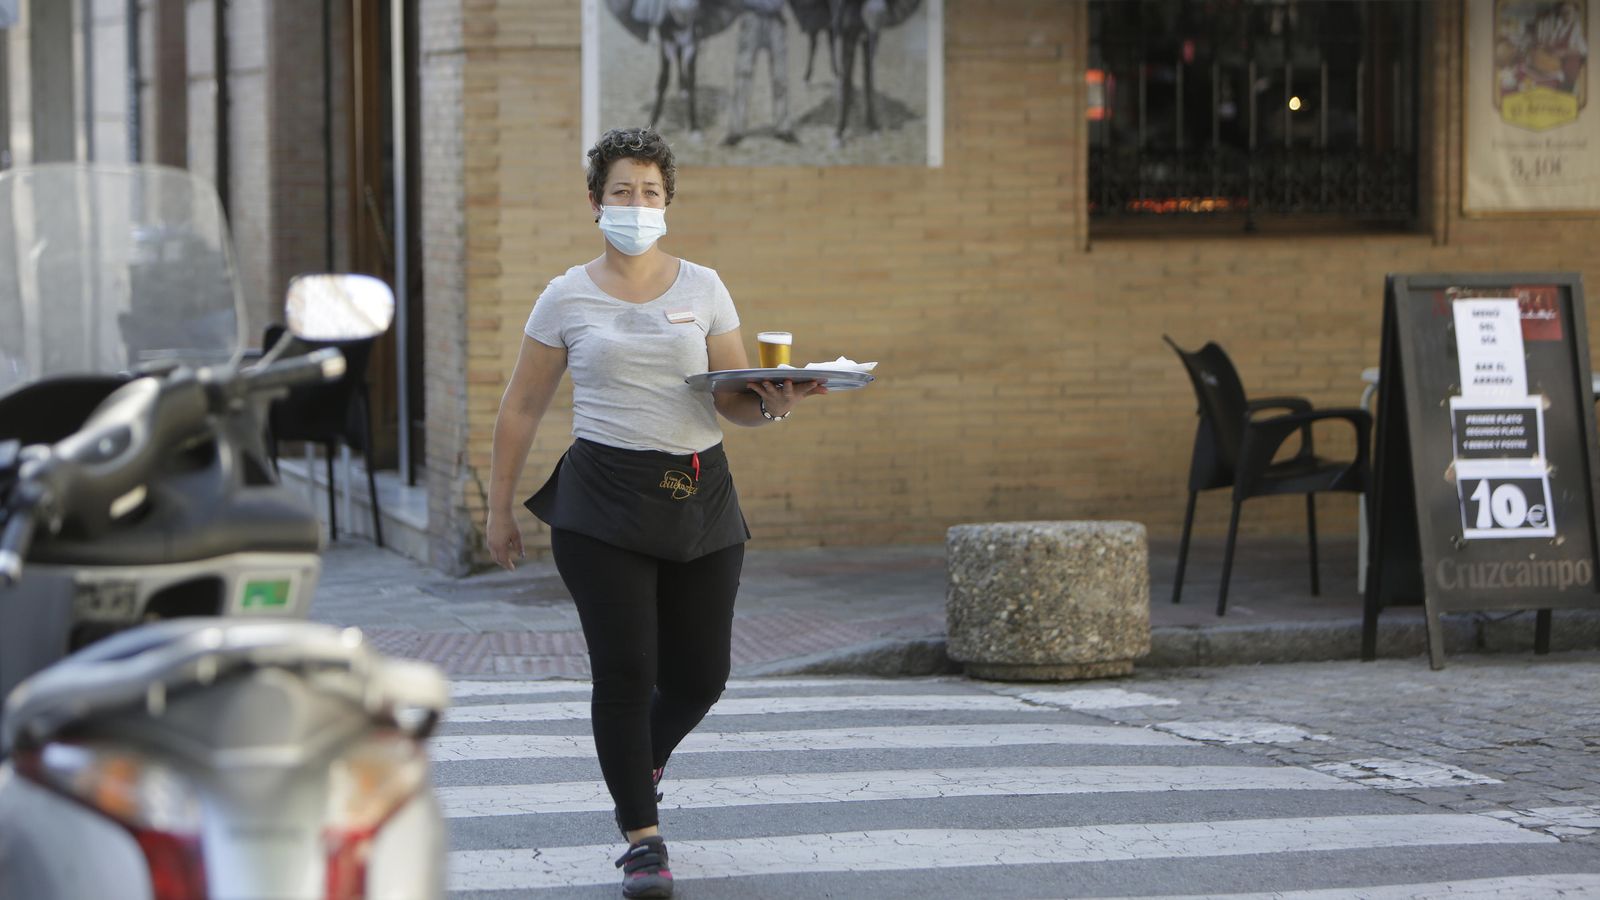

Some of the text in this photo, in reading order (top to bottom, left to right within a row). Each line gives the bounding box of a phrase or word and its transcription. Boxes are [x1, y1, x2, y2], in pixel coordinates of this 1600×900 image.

[1475, 362, 1494, 372] BAR
[1465, 413, 1524, 425] PRIMER PLATO
[1500, 425, 1526, 436] PLATO
[1500, 439, 1528, 450] POSTRE
[1436, 556, 1593, 591] Cruzcampo
